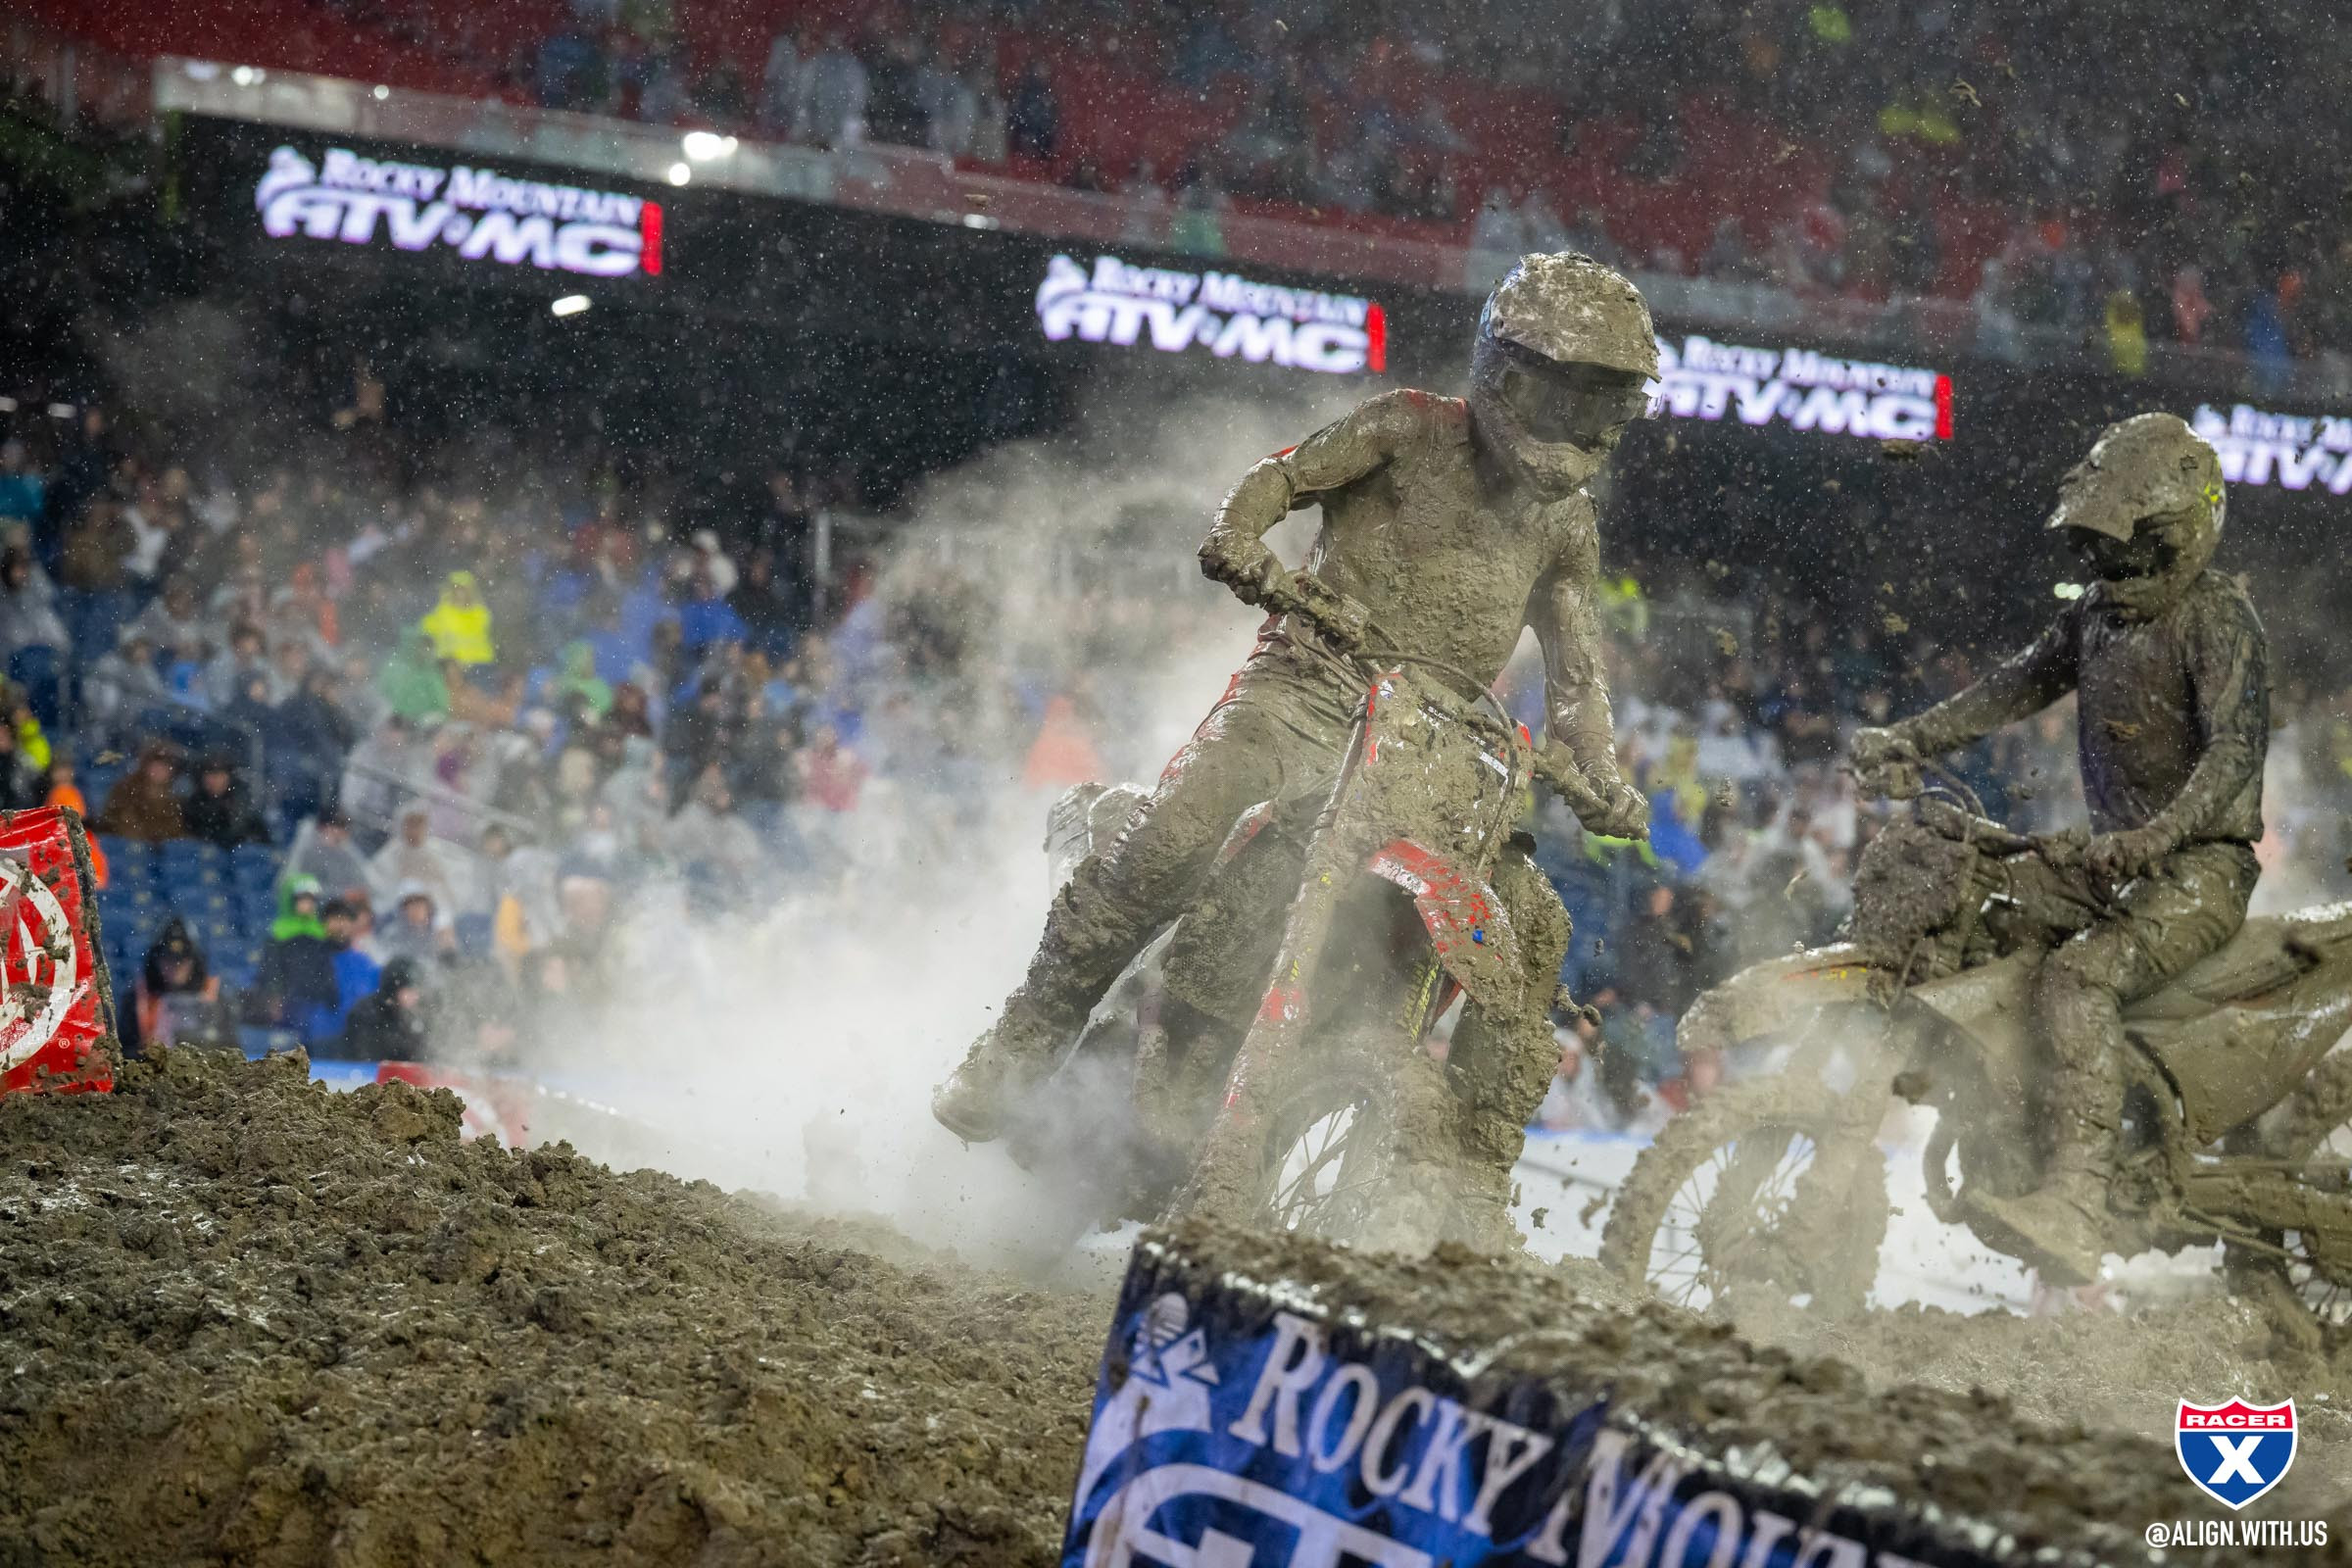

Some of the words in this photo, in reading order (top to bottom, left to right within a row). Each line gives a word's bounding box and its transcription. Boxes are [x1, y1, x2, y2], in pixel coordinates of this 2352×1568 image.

[321, 148, 446, 201] ROCKY
[446, 165, 643, 226] MOUNTAIN
[1092, 255, 1200, 306] ROCKY
[1199, 270, 1369, 327] MOUNTAIN
[1682, 335, 1780, 380] ROCKY
[1229, 1310, 1555, 1537] ROCKY
